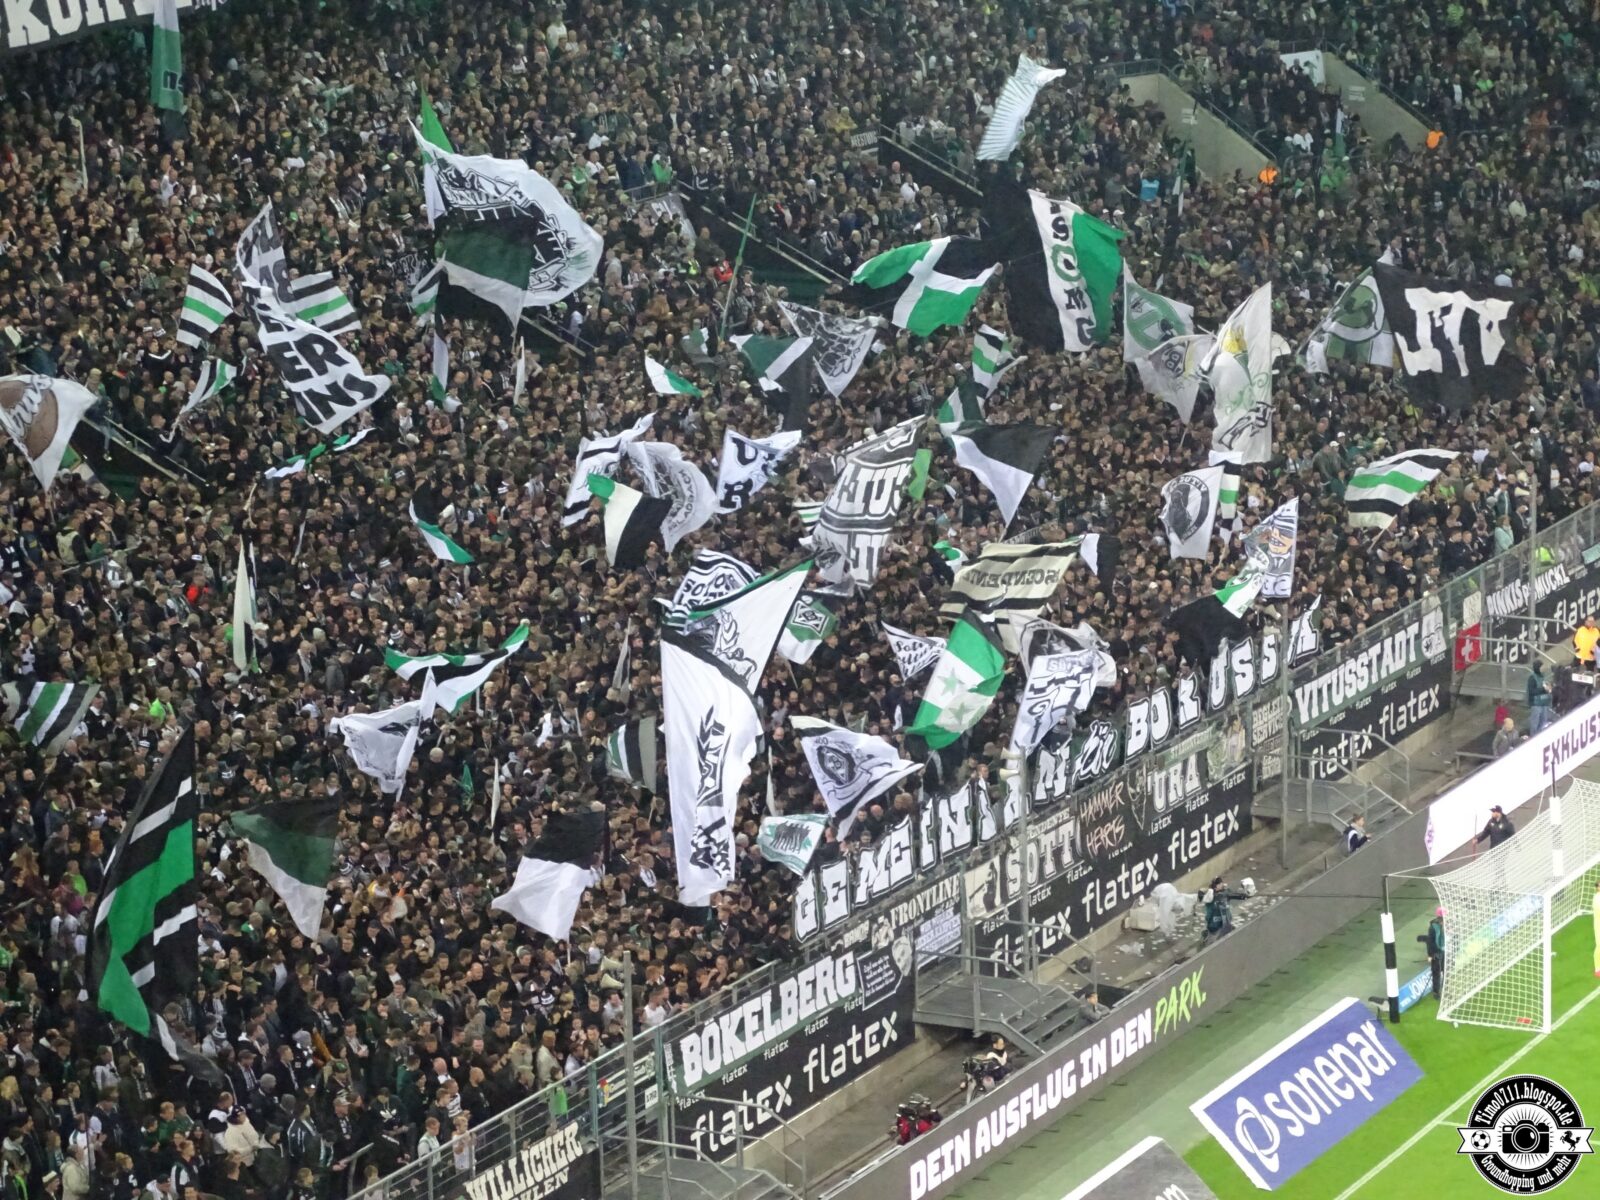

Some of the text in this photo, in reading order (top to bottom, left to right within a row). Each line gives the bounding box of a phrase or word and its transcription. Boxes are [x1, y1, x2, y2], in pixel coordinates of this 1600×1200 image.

[1295, 622, 1419, 724] VITUSSTADT
[1148, 815, 1172, 836] latex
[1168, 803, 1239, 871] flatex
[890, 872, 960, 930] FRONTLINE
[1028, 885, 1052, 907] latex
[1081, 853, 1160, 923] flatex
[680, 951, 856, 1088] BÖKELBERG
[802, 1010, 898, 1093] flatex
[910, 1128, 971, 1200] DEIN
[975, 1057, 1077, 1160] AUSFLUG
[1080, 1037, 1107, 1088] IN
[1110, 1007, 1152, 1068] DEN
[1263, 1019, 1397, 1138] sonepar
[462, 1121, 584, 1200] WILLICHER
